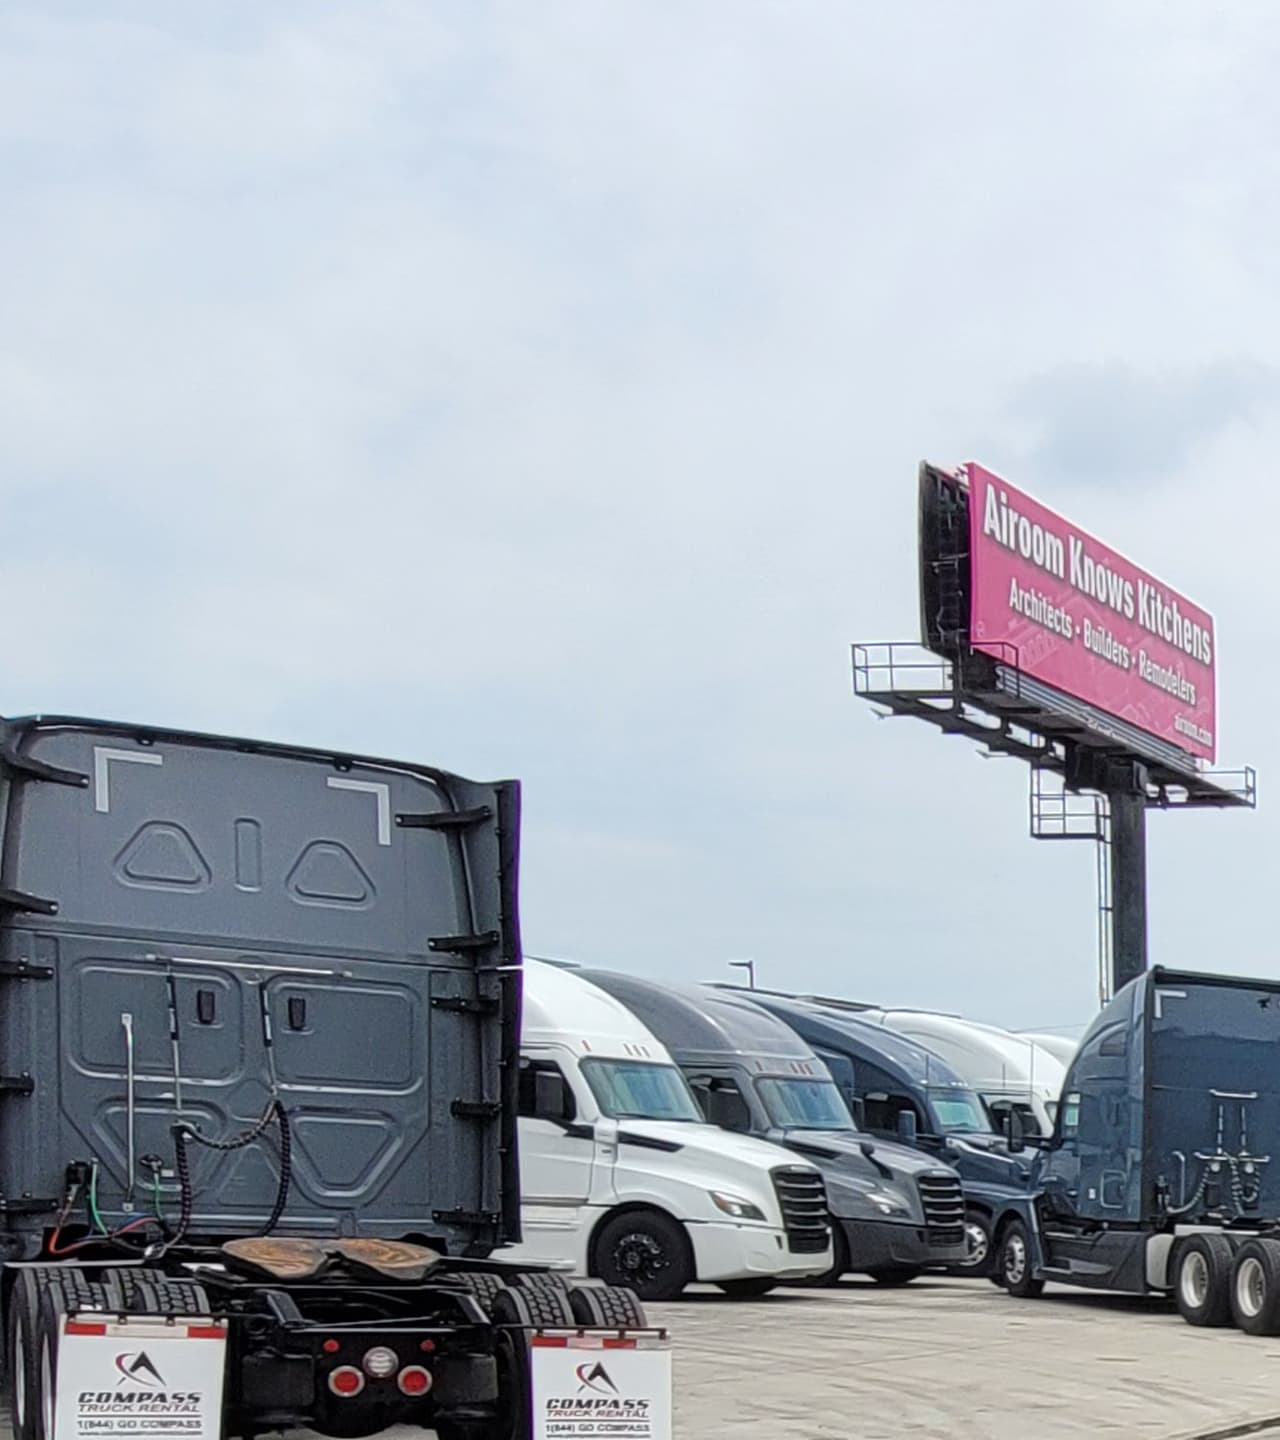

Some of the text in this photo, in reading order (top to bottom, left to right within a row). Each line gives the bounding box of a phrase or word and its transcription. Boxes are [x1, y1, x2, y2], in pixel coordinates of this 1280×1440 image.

[984, 484, 1211, 665] Airoom Knows Kitchens
[1009, 578, 1196, 706] Architects Builders Remodelers
[78, 1391, 203, 1404] COMPASS
[79, 1403, 200, 1412] TRUCK RENTAL
[545, 1398, 650, 1409] COMPASS
[547, 1409, 649, 1418] TRUCK RENTAL
[117, 1420, 137, 1429] GO
[140, 1420, 202, 1429] COMPASS
